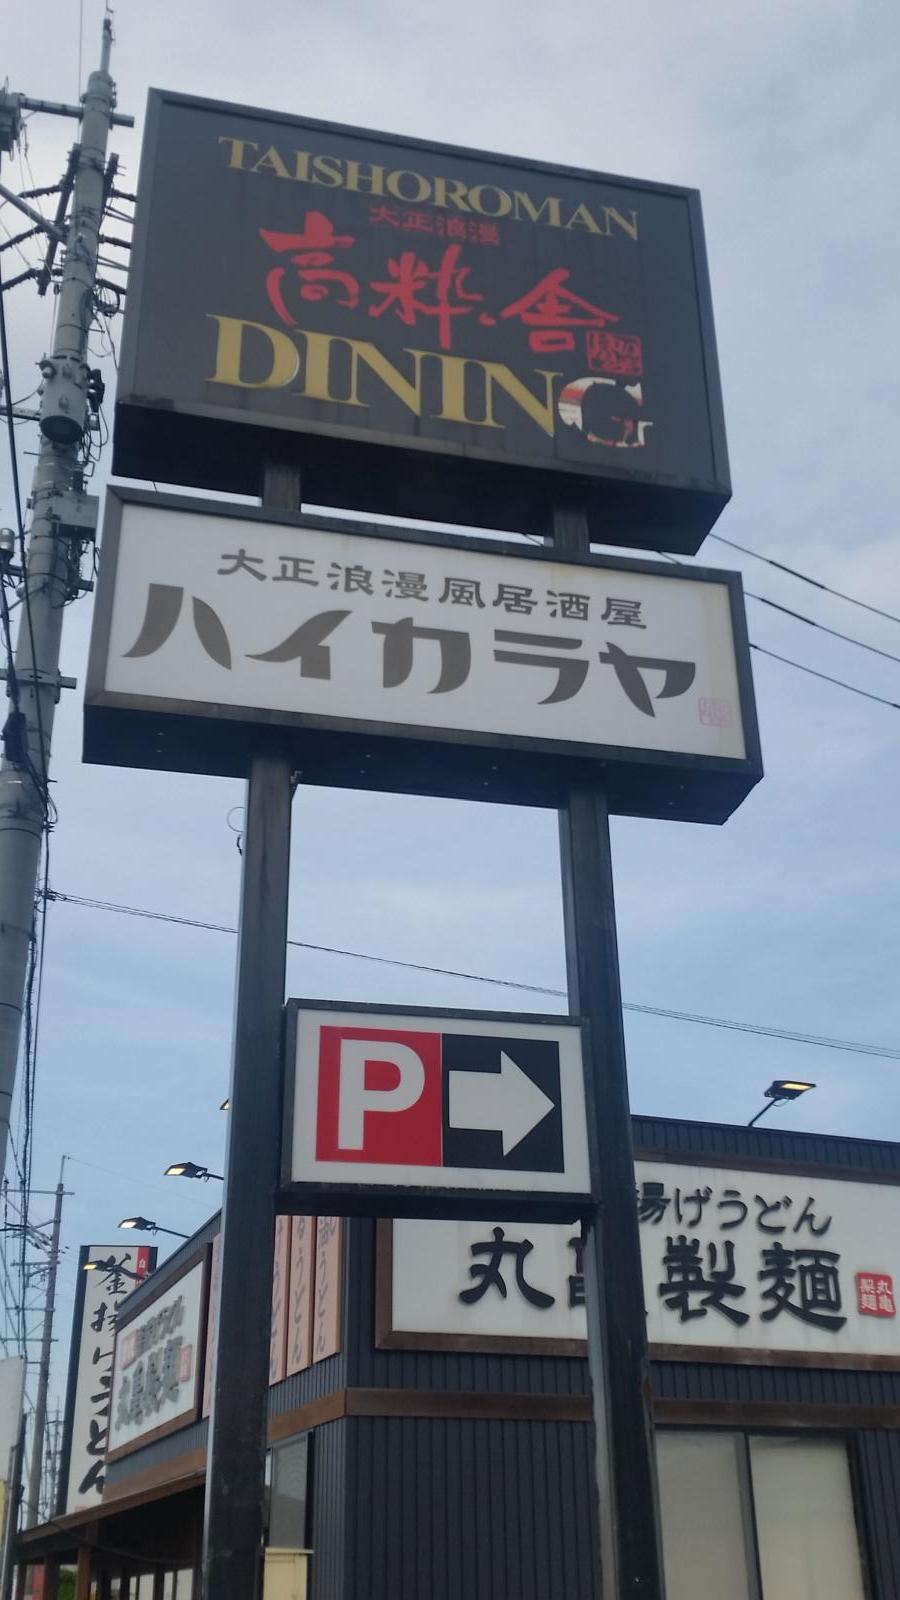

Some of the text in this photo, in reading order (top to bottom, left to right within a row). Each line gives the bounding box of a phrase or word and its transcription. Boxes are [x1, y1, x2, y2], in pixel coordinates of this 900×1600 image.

[218, 136, 638, 242] TAISHOROMAN
[206, 312, 653, 448] DINING
[216, 547, 648, 630] 大正浪漫風居酒屋
[121, 582, 696, 718] ハイカラヤ
[337, 1038, 426, 1150] P
